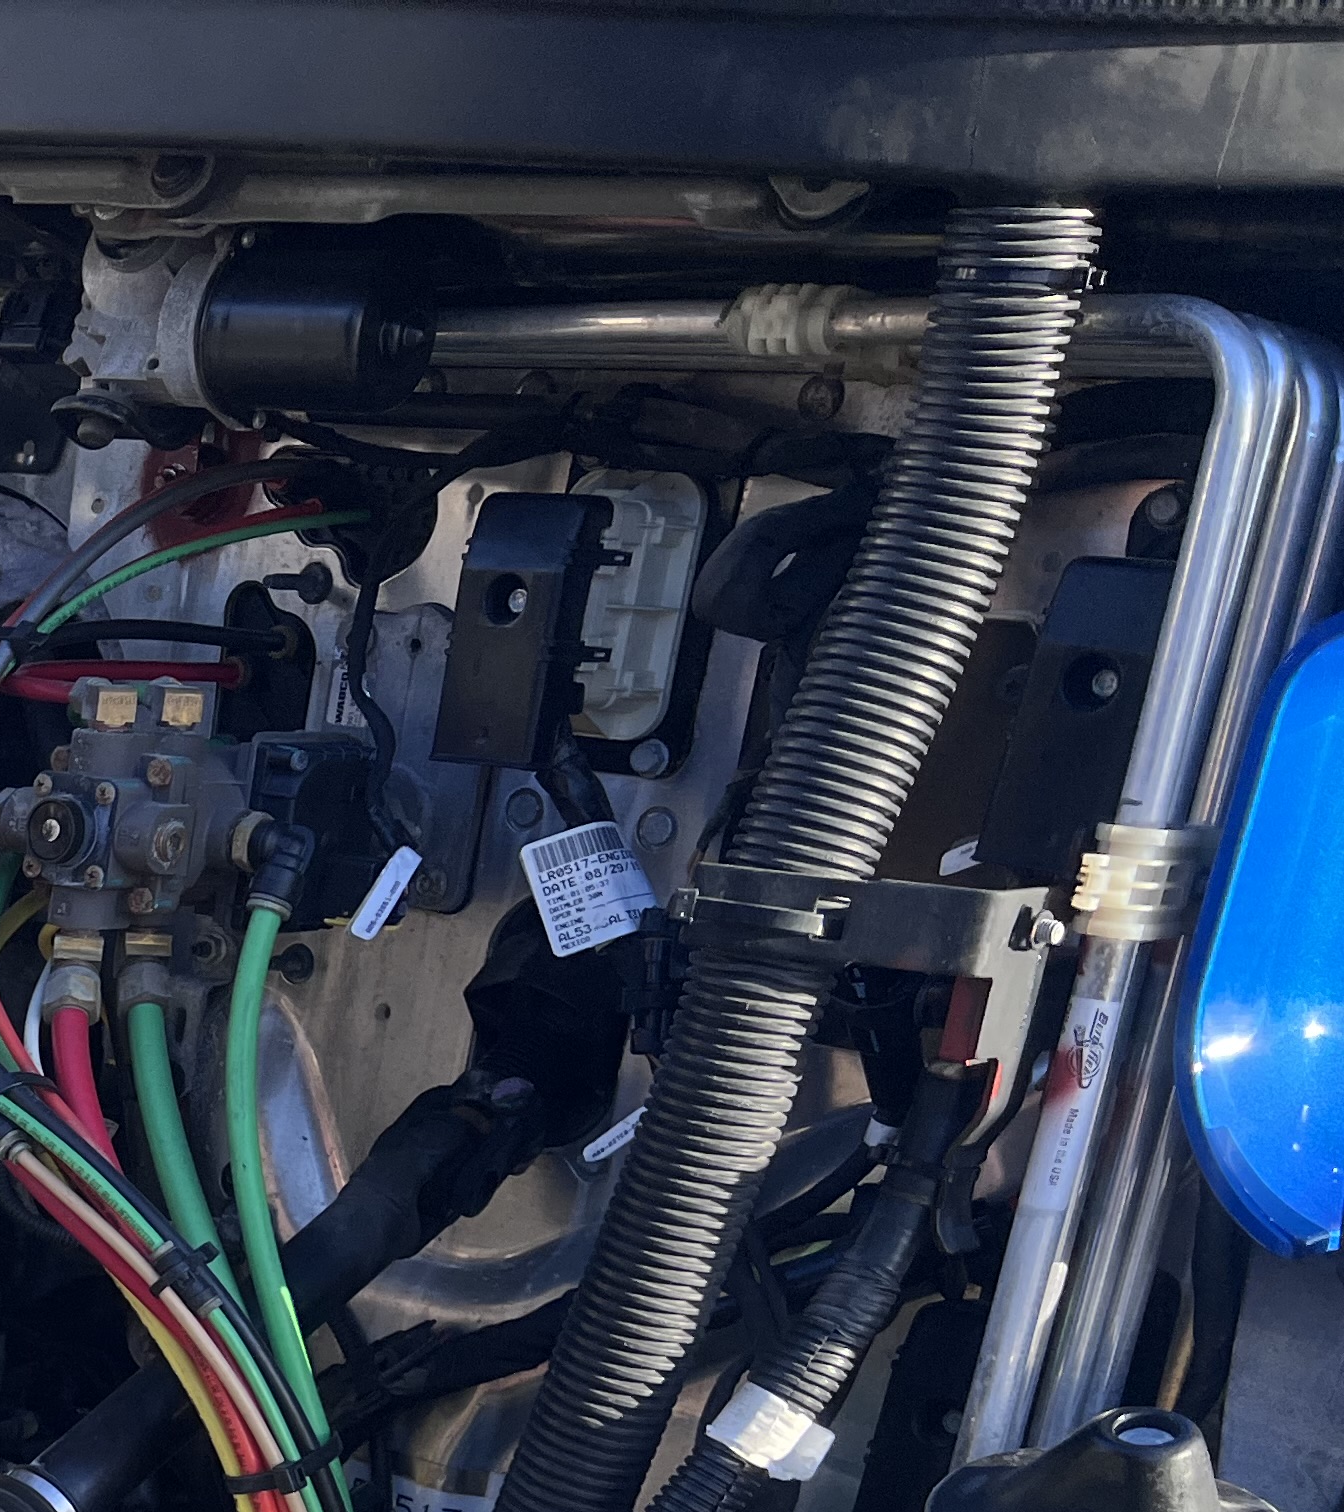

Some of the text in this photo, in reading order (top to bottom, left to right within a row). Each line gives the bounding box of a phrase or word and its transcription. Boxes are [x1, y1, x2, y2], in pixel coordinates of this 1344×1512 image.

[335, 672, 348, 723] WABCO
[555, 916, 584, 931] ENGINE
[561, 936, 591, 951] MEXICO
[1063, 1107, 1079, 1134] Made
[1048, 1166, 1061, 1187] USA
